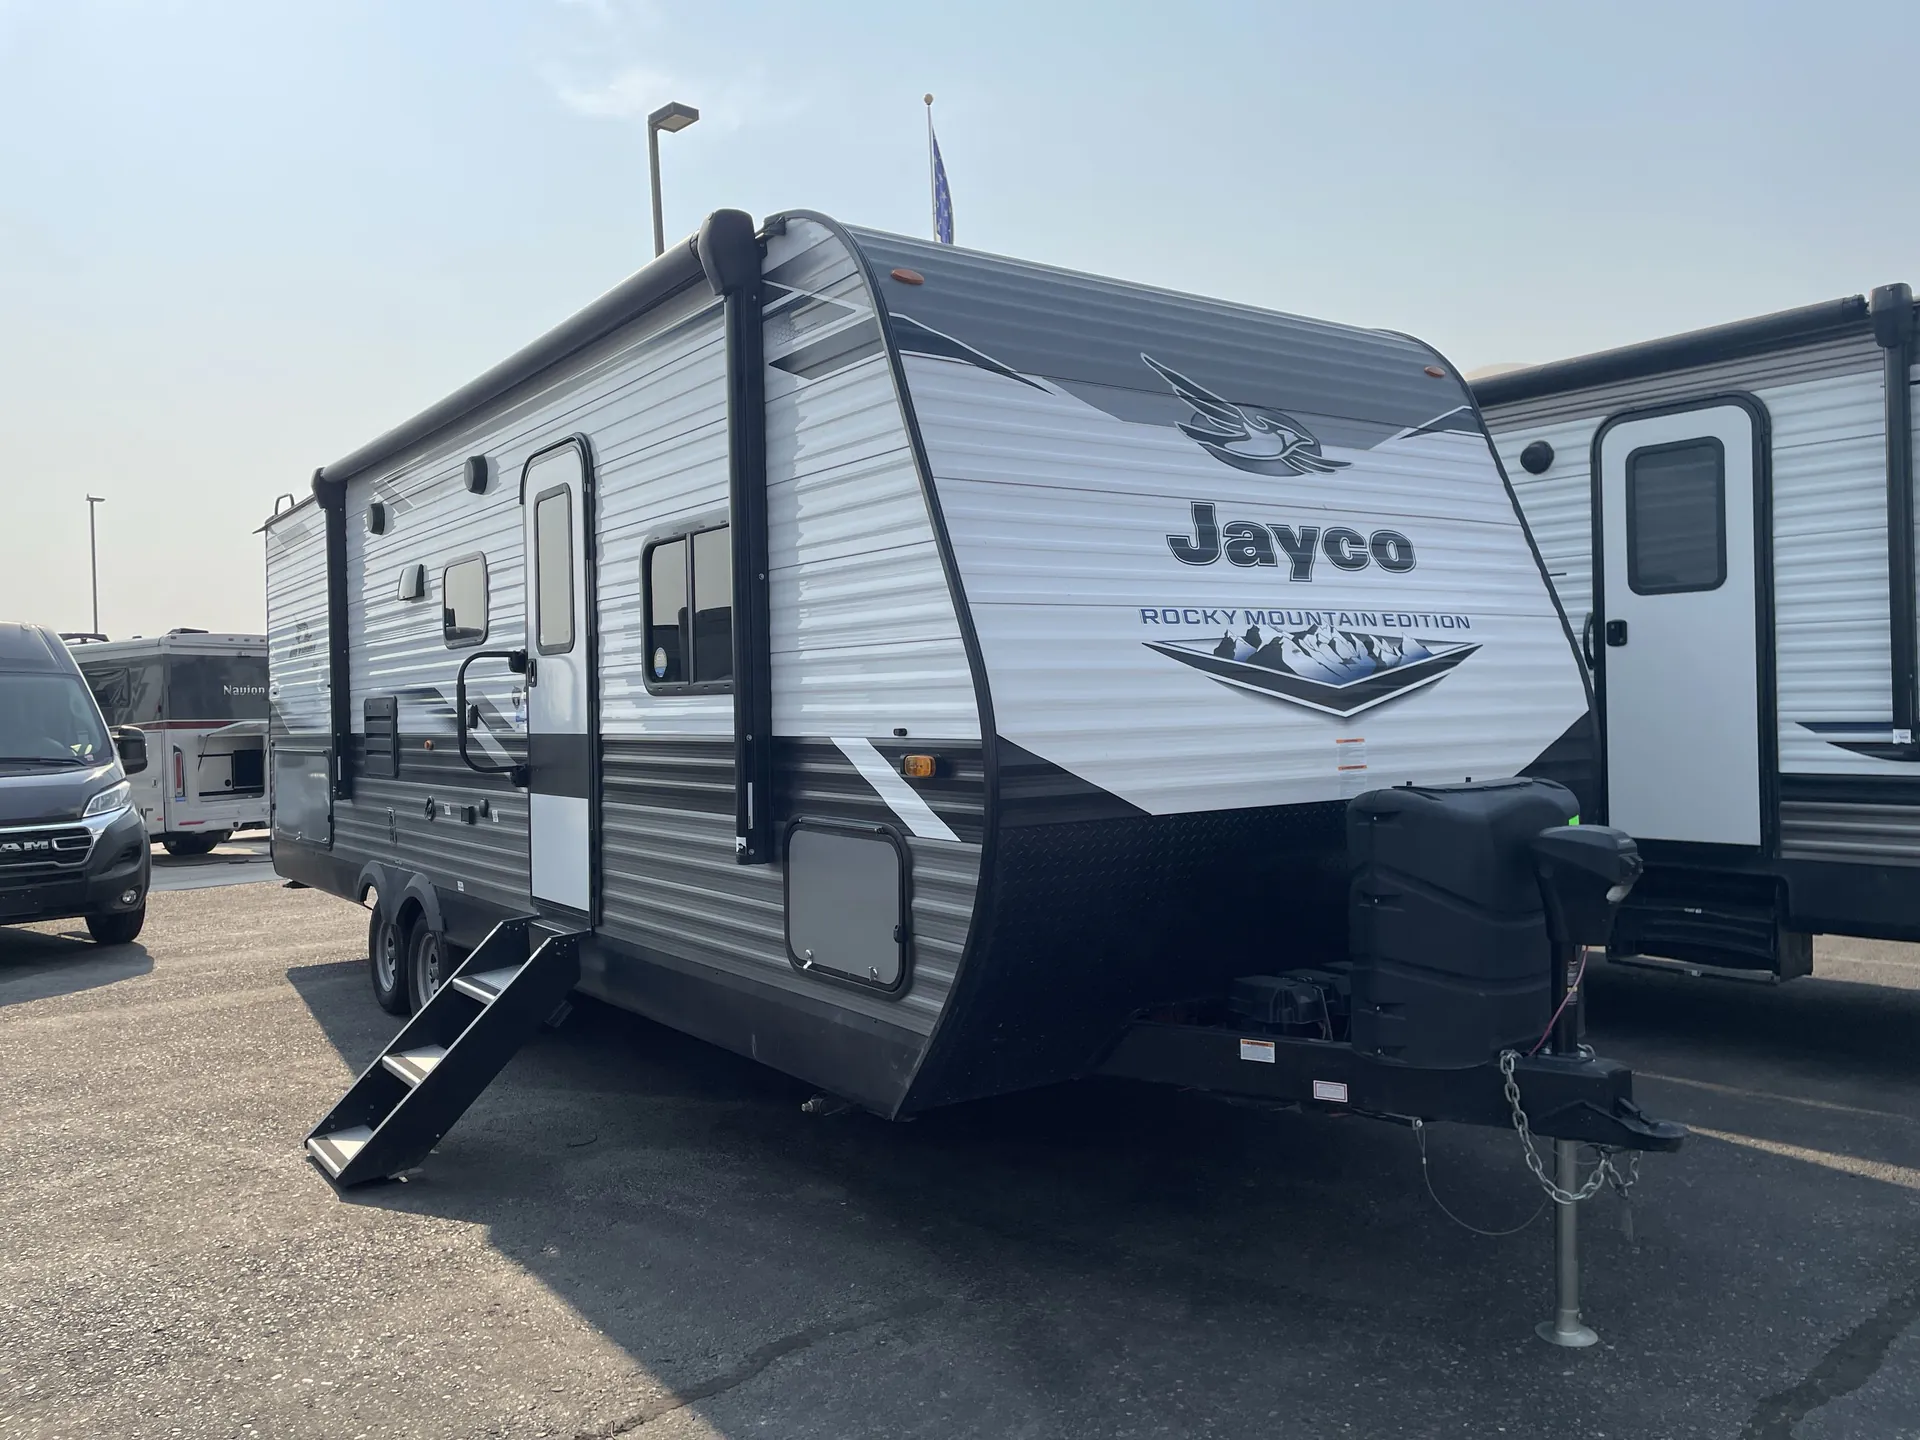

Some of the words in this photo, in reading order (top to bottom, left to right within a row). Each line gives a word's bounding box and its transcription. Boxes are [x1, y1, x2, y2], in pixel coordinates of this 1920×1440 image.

[1166, 501, 1417, 582] Jayco
[1140, 608, 1237, 625] ROCKY
[1245, 610, 1378, 628] MOUNTAIN
[1381, 613, 1471, 629] EDITION
[223, 684, 265, 696] Navion
[0, 840, 49, 853] AM
